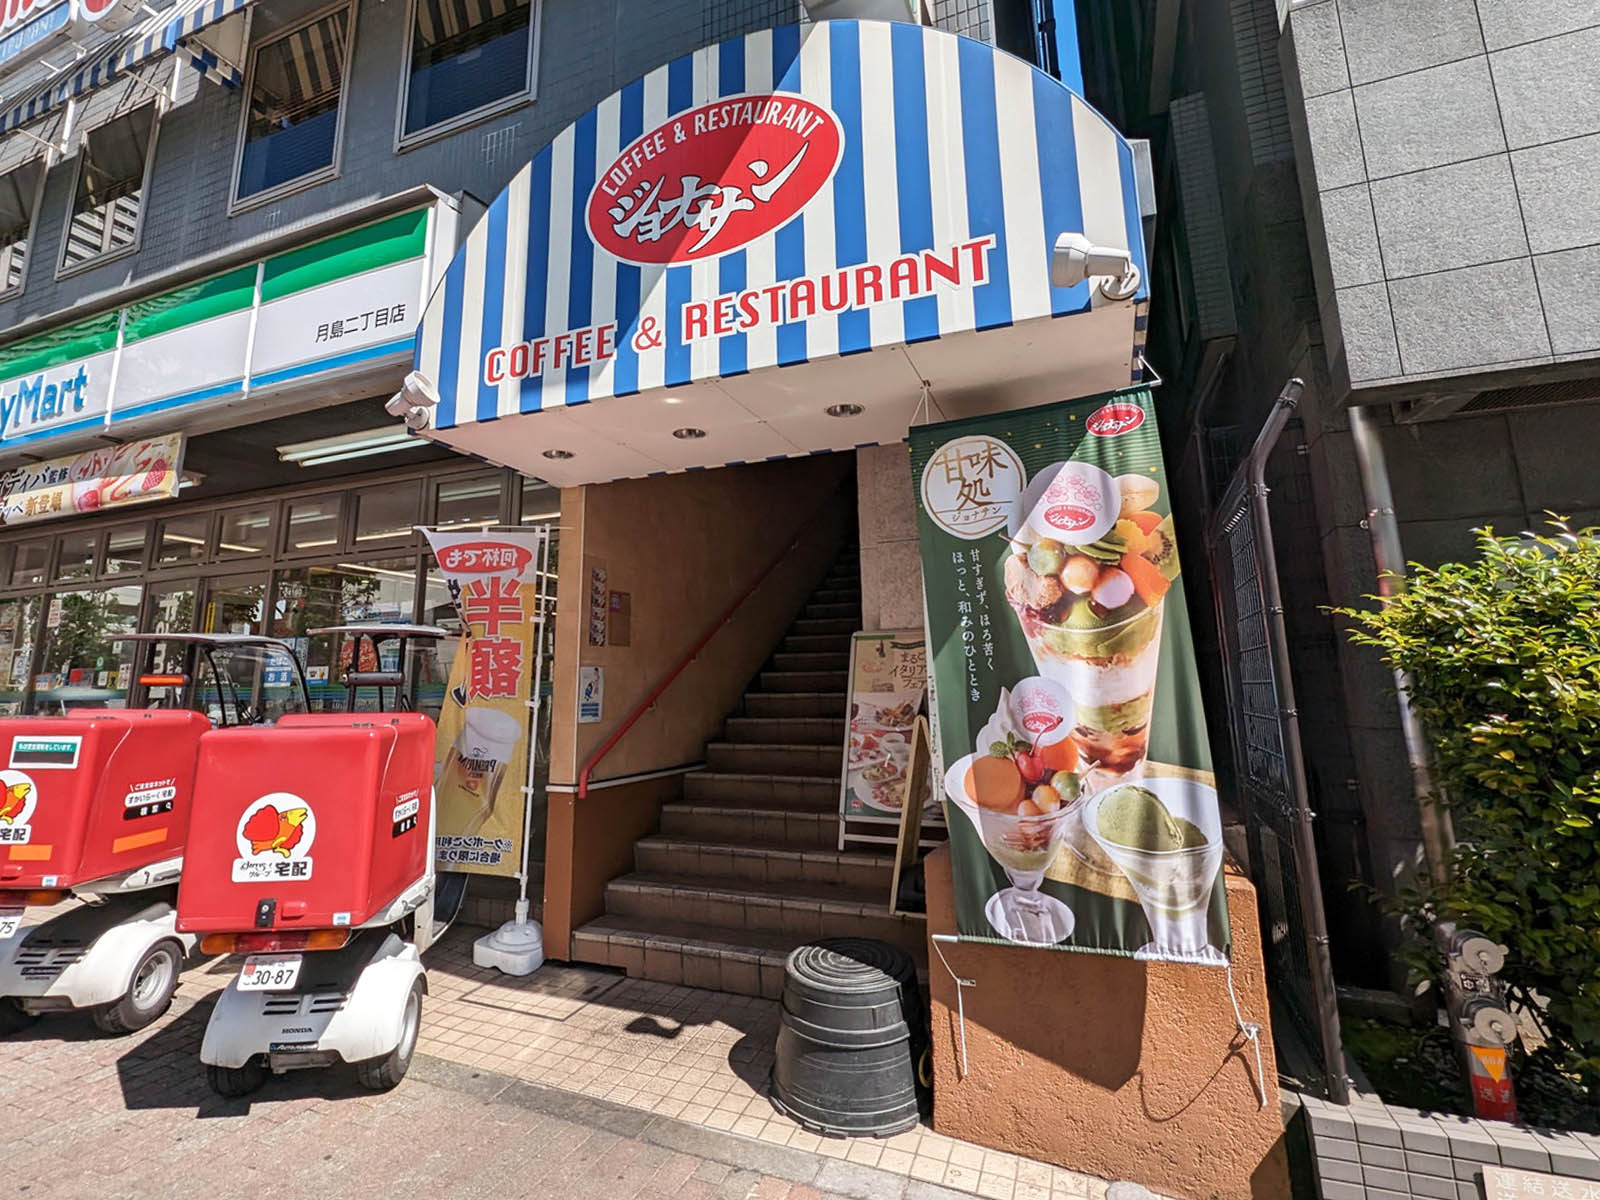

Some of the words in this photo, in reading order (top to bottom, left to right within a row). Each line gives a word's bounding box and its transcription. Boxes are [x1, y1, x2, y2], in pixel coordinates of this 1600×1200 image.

[601, 131, 667, 197] COFFEE
[673, 122, 687, 144] &
[694, 101, 825, 138] RESTAURANT
[607, 141, 810, 254] ジョナサン
[315, 303, 406, 343] 月島二丁目店
[485, 325, 617, 384] COFFEE
[634, 316, 663, 351] &
[684, 237, 993, 342] RESTAURANT
[952, 551, 981, 702] ほっと、和みのひととき
[969, 548, 995, 671] 甘すぎず、ほろ苦く
[0, 828, 27, 842] 宅配
[274, 861, 308, 877] 宅配
[281, 1027, 314, 1035] HONDA
